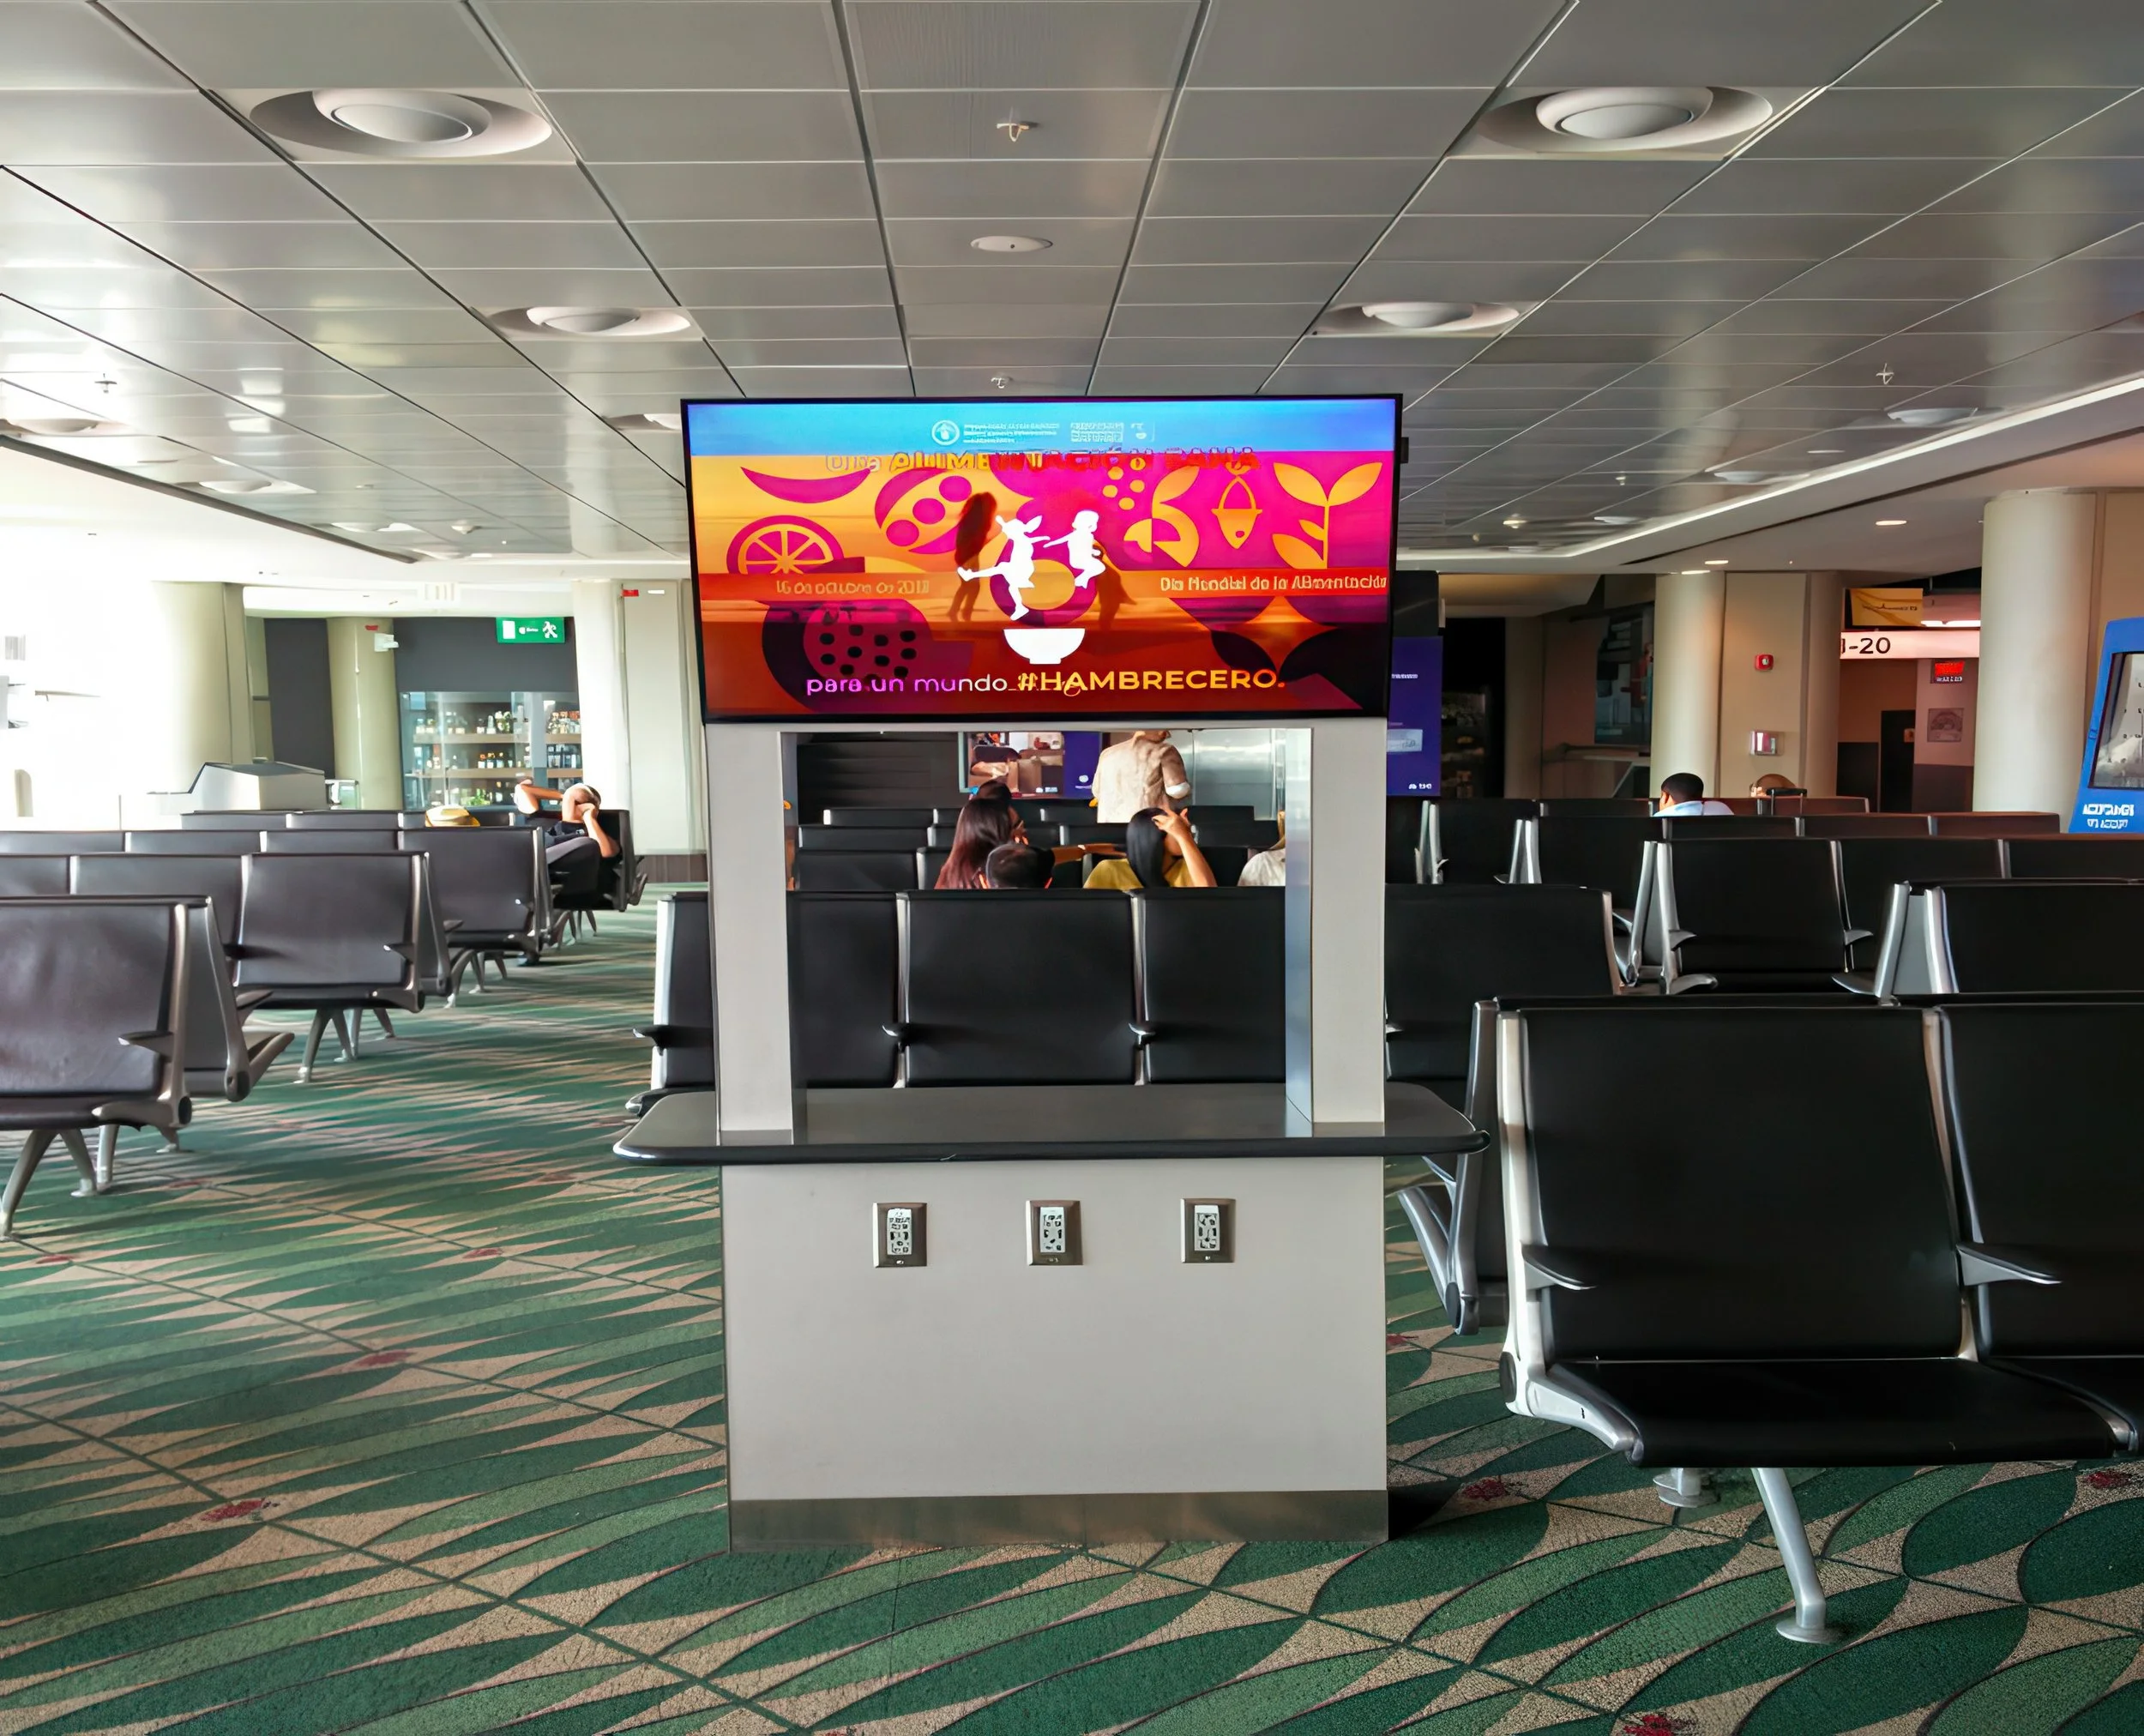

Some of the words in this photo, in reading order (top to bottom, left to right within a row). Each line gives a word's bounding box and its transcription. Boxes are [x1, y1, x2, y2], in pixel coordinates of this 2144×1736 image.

[807, 678, 862, 696] para
[871, 678, 904, 692] un
[914, 673, 1008, 692] mundo
